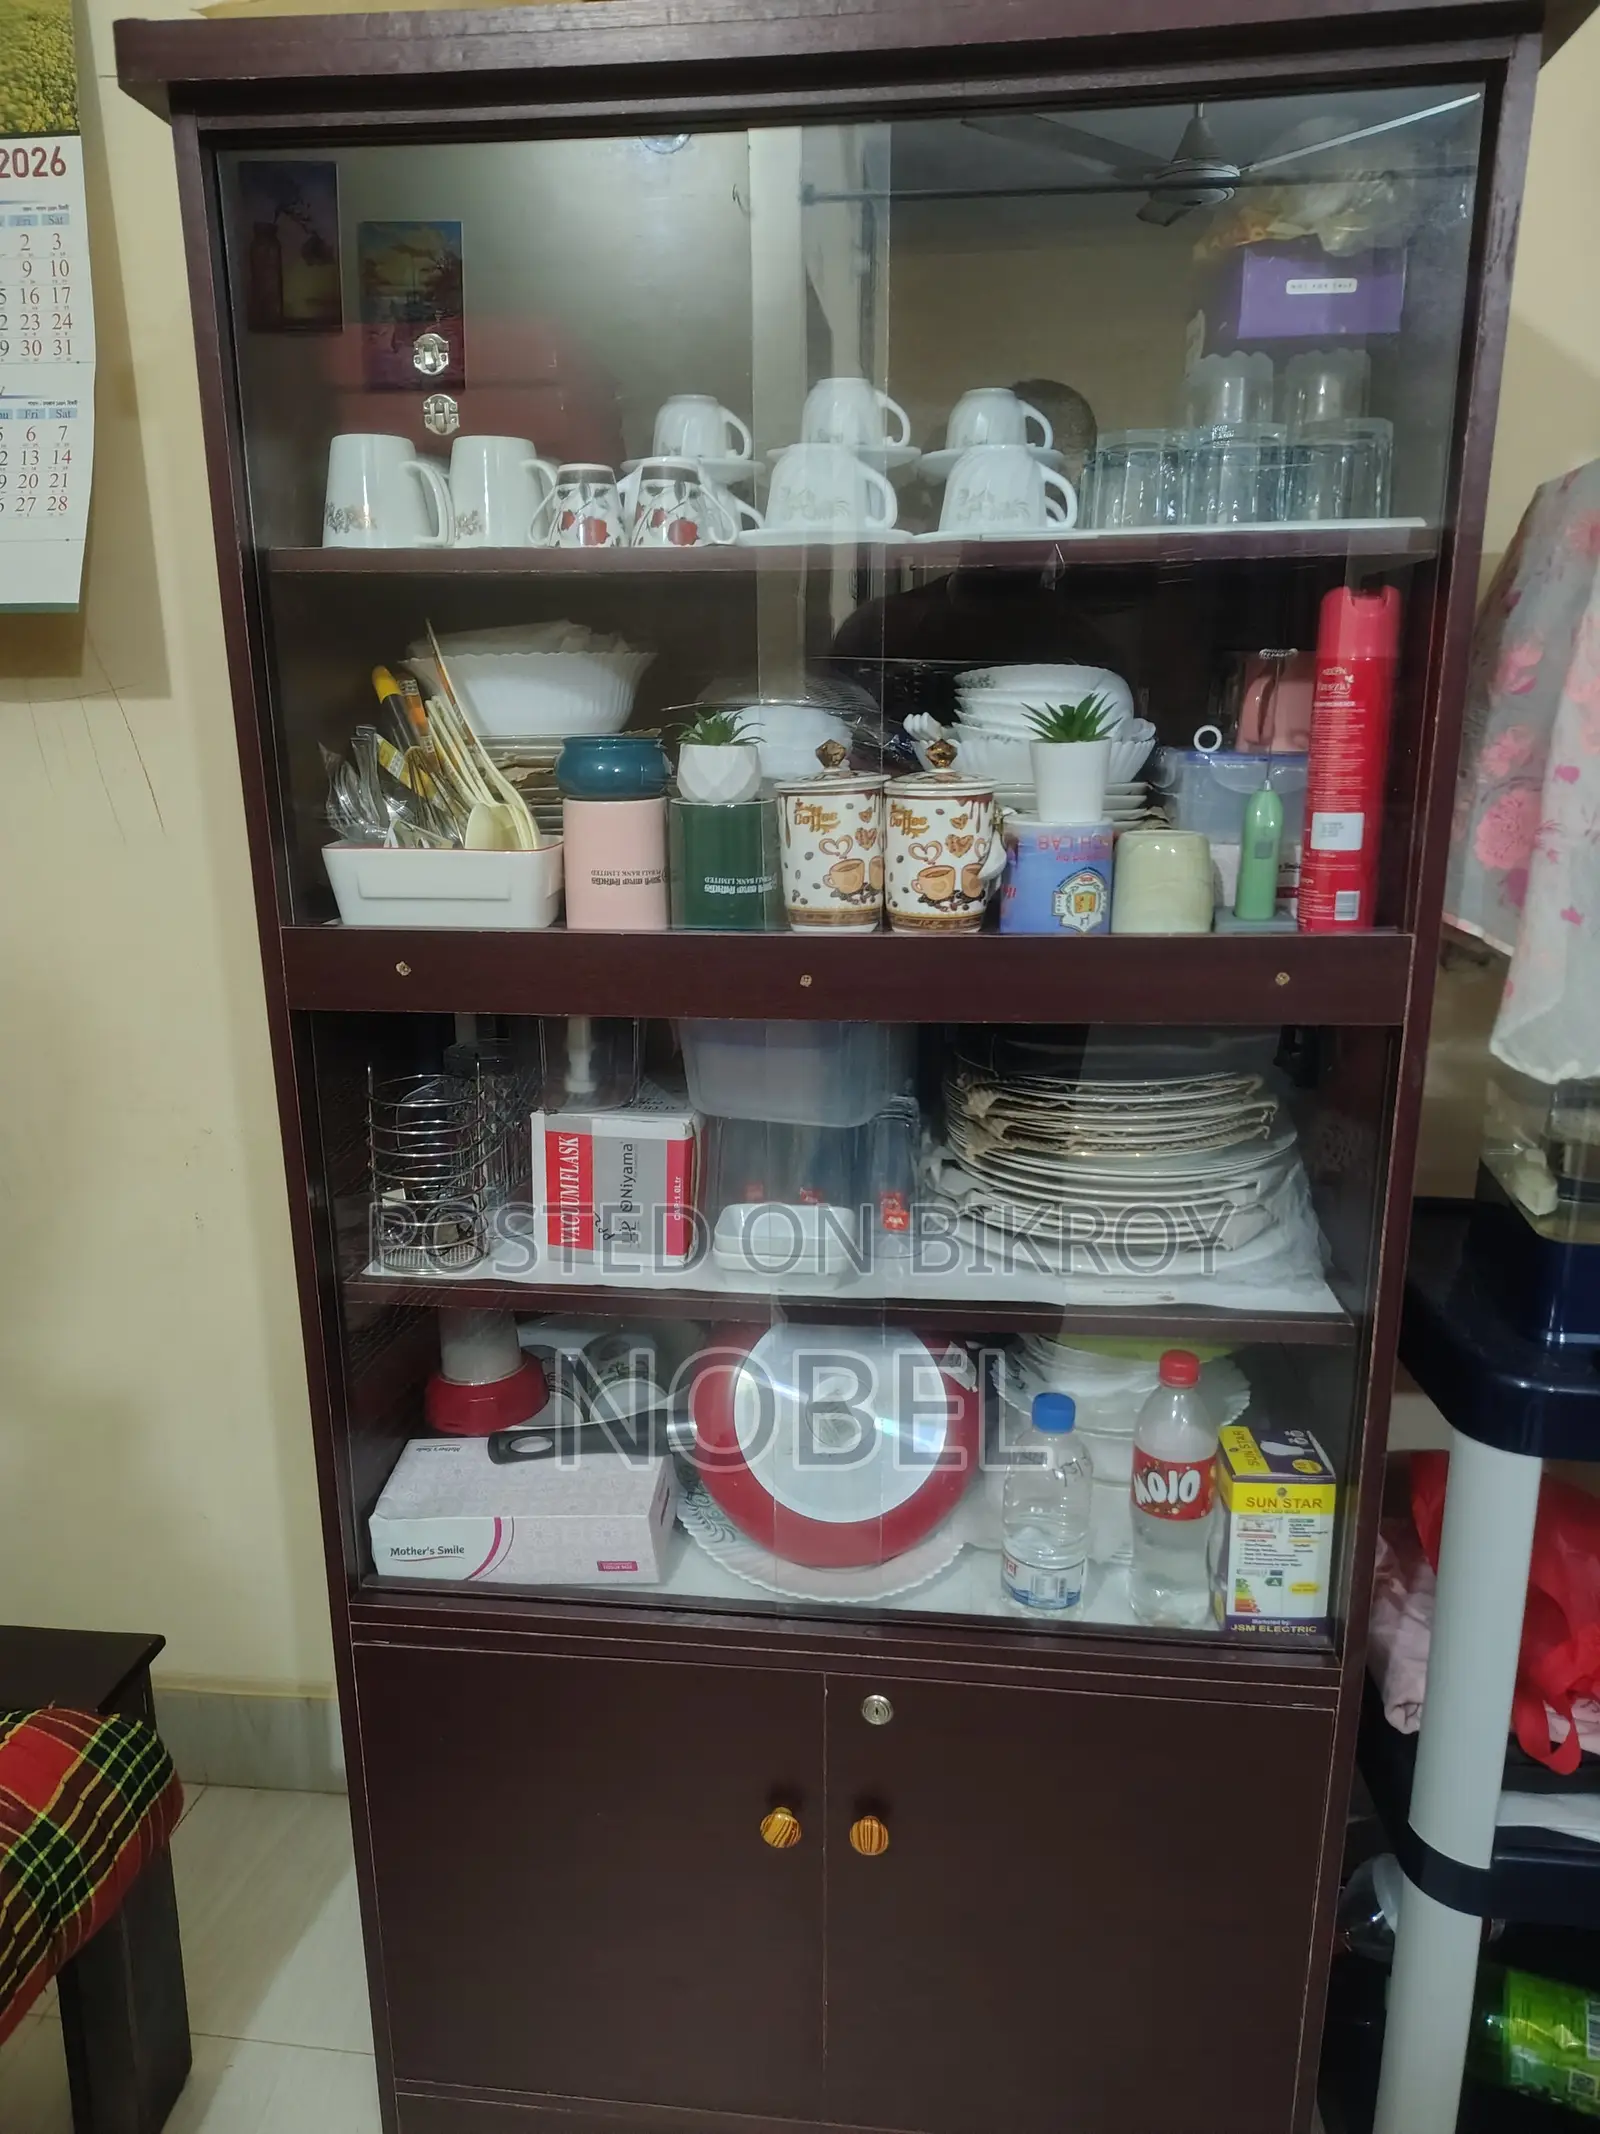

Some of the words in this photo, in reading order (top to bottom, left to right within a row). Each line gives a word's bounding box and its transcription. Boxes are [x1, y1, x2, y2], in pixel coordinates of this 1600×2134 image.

[0, 146, 67, 178] 2026
[48, 214, 63, 225] Sat
[20, 233, 30, 251] 2
[52, 233, 61, 250] 3
[22, 260, 32, 278] 9
[51, 259, 69, 277] 10
[0, 288, 7, 304] 5
[21, 287, 40, 304] 16
[53, 286, 71, 304] 17
[0, 314, 8, 331] 2
[20, 313, 40, 331] 23
[52, 312, 73, 330] 24
[0, 339, 10, 357] 9
[20, 339, 42, 357] 30
[53, 339, 71, 356] 31
[25, 409, 39, 419] Fri
[56, 408, 71, 419] Sat
[26, 425, 36, 442] 6
[58, 425, 68, 441] 7
[0, 450, 8, 466] 2
[21, 450, 39, 466] 13
[53, 449, 72, 465] 14
[0, 474, 7, 490] 9
[17, 473, 39, 489] 20
[49, 472, 67, 488] 21
[15, 496, 37, 512] 27
[47, 495, 68, 511] 28
[558, 1136, 580, 1182] FLASK
[619, 1143, 637, 1199] Niyama
[559, 1183, 581, 1244] VACUUM
[1133, 1469, 1201, 1506] MOJO
[1245, 1496, 1278, 1509] SUN
[1282, 1498, 1323, 1509] STAR
[390, 1546, 435, 1557] Mother's
[437, 1544, 465, 1554] Smile
[1231, 1623, 1256, 1632] JSM
[1258, 1625, 1318, 1633] ELECTRIC
